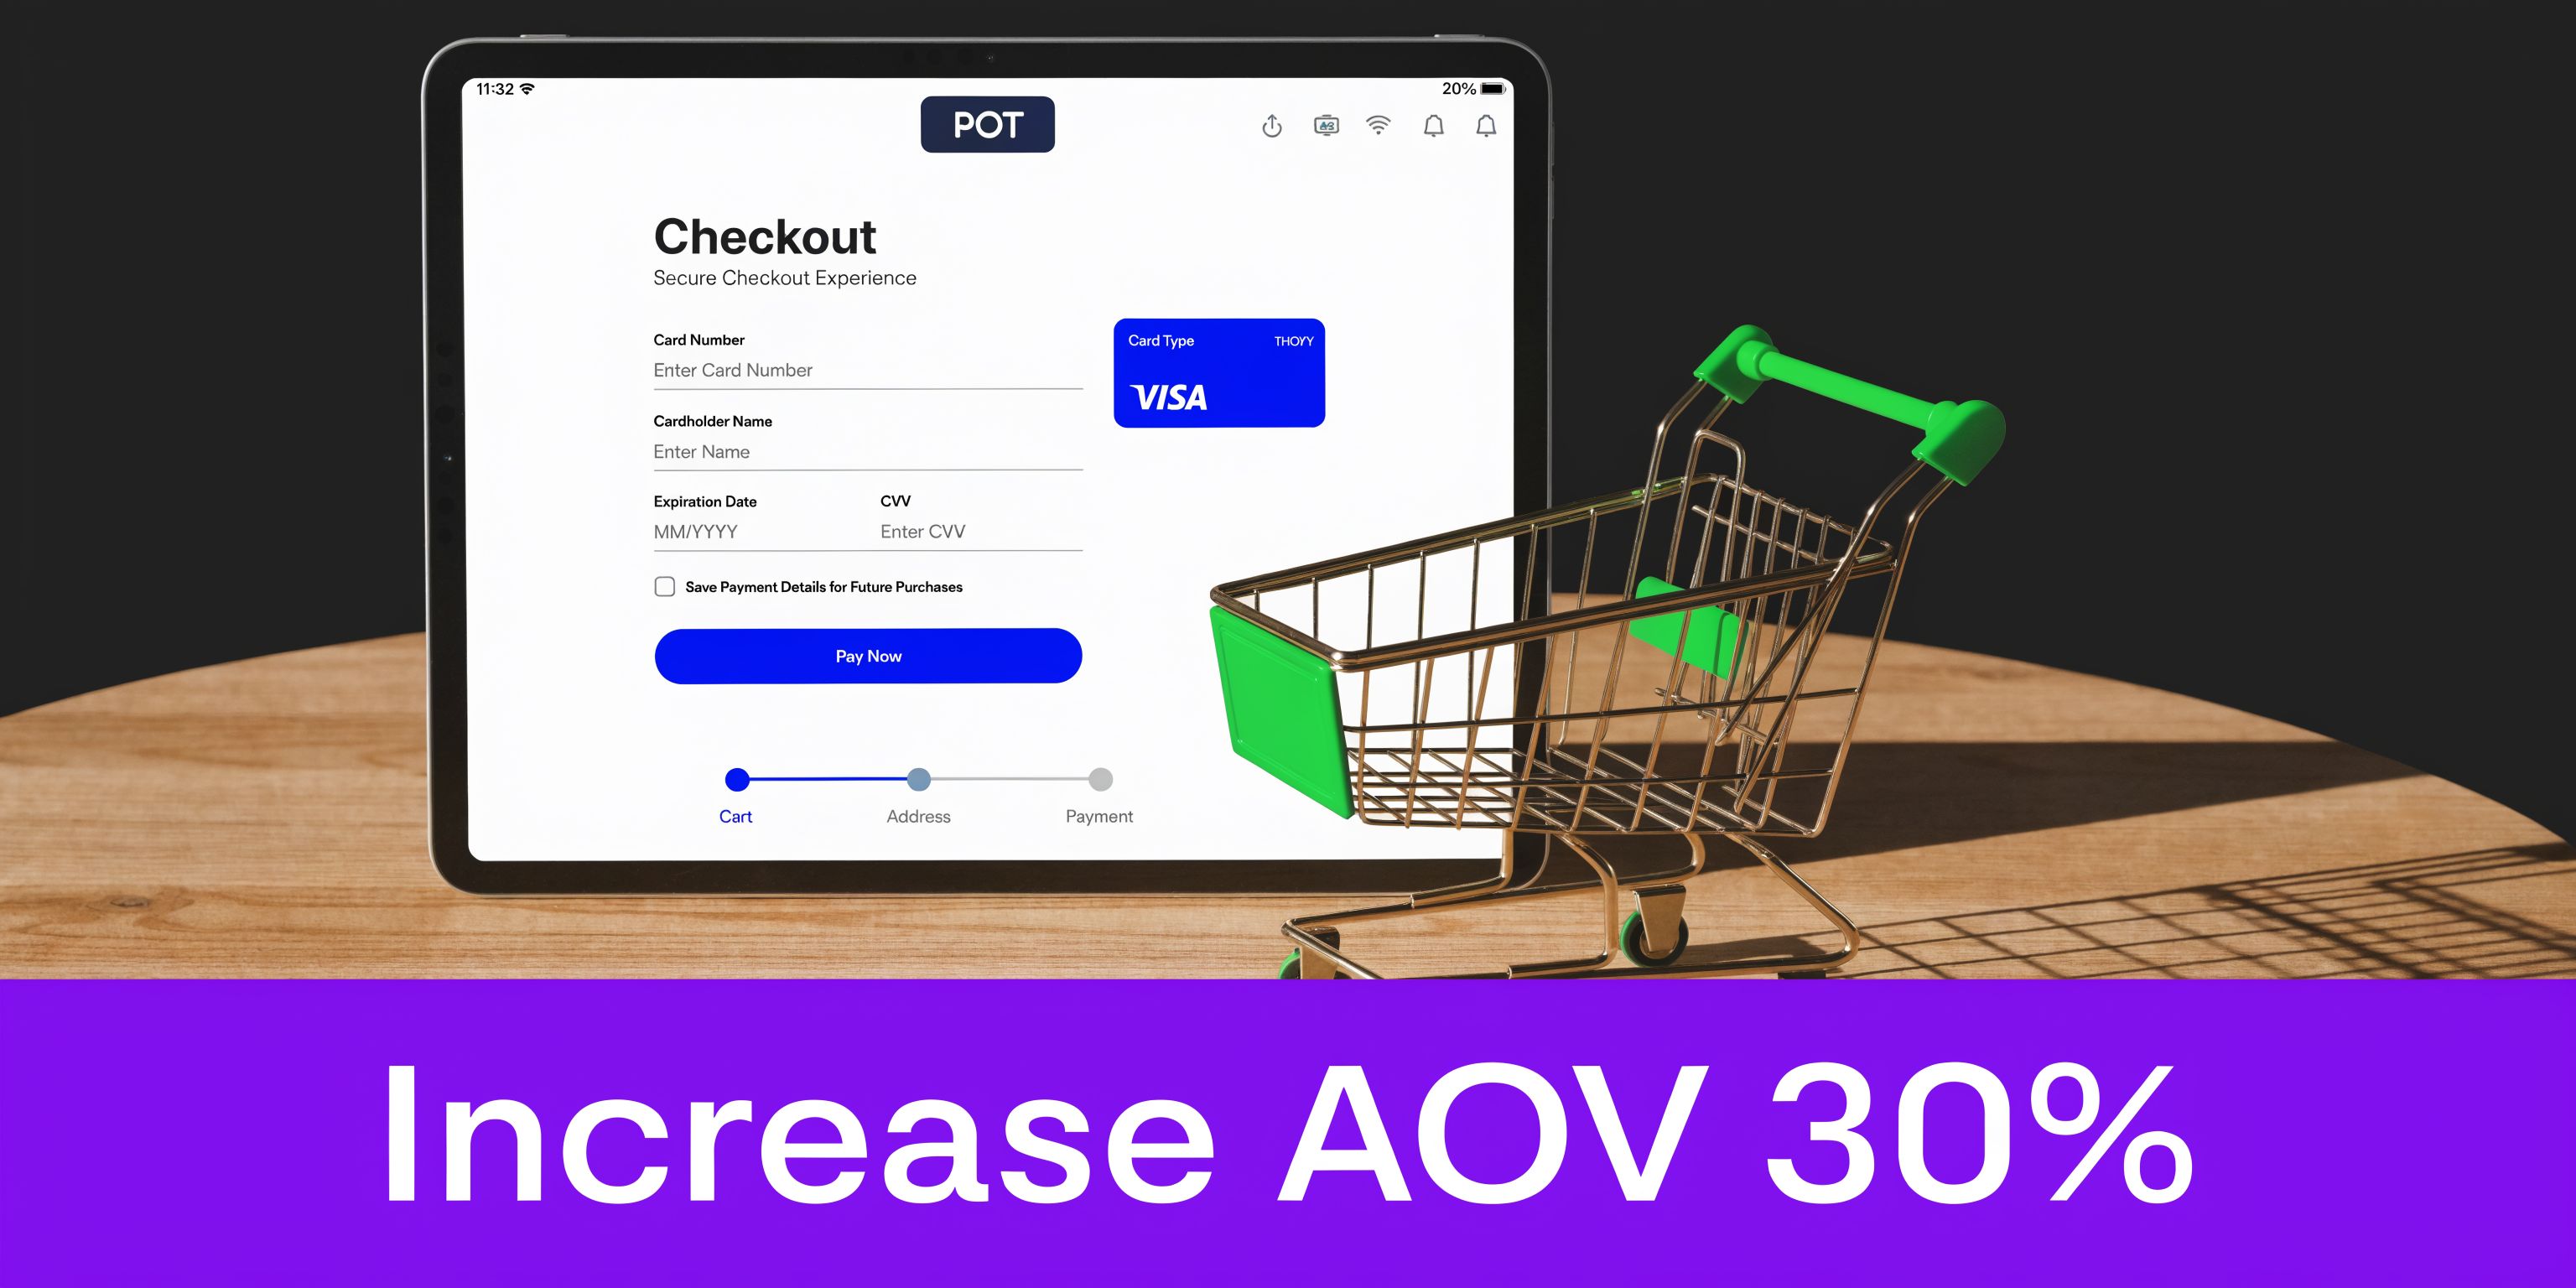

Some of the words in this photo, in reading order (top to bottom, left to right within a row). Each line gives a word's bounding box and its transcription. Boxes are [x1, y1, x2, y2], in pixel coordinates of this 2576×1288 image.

[476, 82, 514, 96] 11:32
[1442, 81, 1477, 96] 20%
[954, 110, 1025, 139] POT
[655, 217, 877, 255] Checkout
[653, 269, 717, 286] Secure
[722, 269, 811, 286] Checkout
[816, 269, 917, 289] Experience
[653, 333, 687, 346] Card
[690, 333, 745, 346] Number
[1128, 334, 1161, 347] Card
[1162, 334, 1195, 351] Type
[1274, 335, 1315, 347] THOYY
[654, 362, 698, 378] Enter
[702, 362, 741, 377] Card
[747, 362, 813, 377] Number
[1129, 383, 1208, 411] VISA
[653, 414, 731, 428] Cardholder
[732, 414, 773, 428] Name
[654, 444, 698, 460] Enter
[702, 444, 750, 460] Name
[654, 495, 722, 511] Expiration
[725, 495, 757, 508] Date
[880, 494, 911, 507] CVV
[654, 523, 738, 539] MM/YYYY
[881, 523, 925, 539] Enter
[928, 523, 967, 539] CVV
[685, 580, 718, 593] Save
[720, 580, 779, 595] Payment
[781, 580, 827, 593] Details
[828, 580, 848, 593] for
[850, 580, 893, 593] Future
[896, 580, 963, 593] Purchases
[836, 649, 865, 667] Pay
[867, 649, 903, 663] Now
[719, 809, 753, 823] Cart
[886, 808, 952, 823] Address
[1067, 808, 1134, 827] Payment
